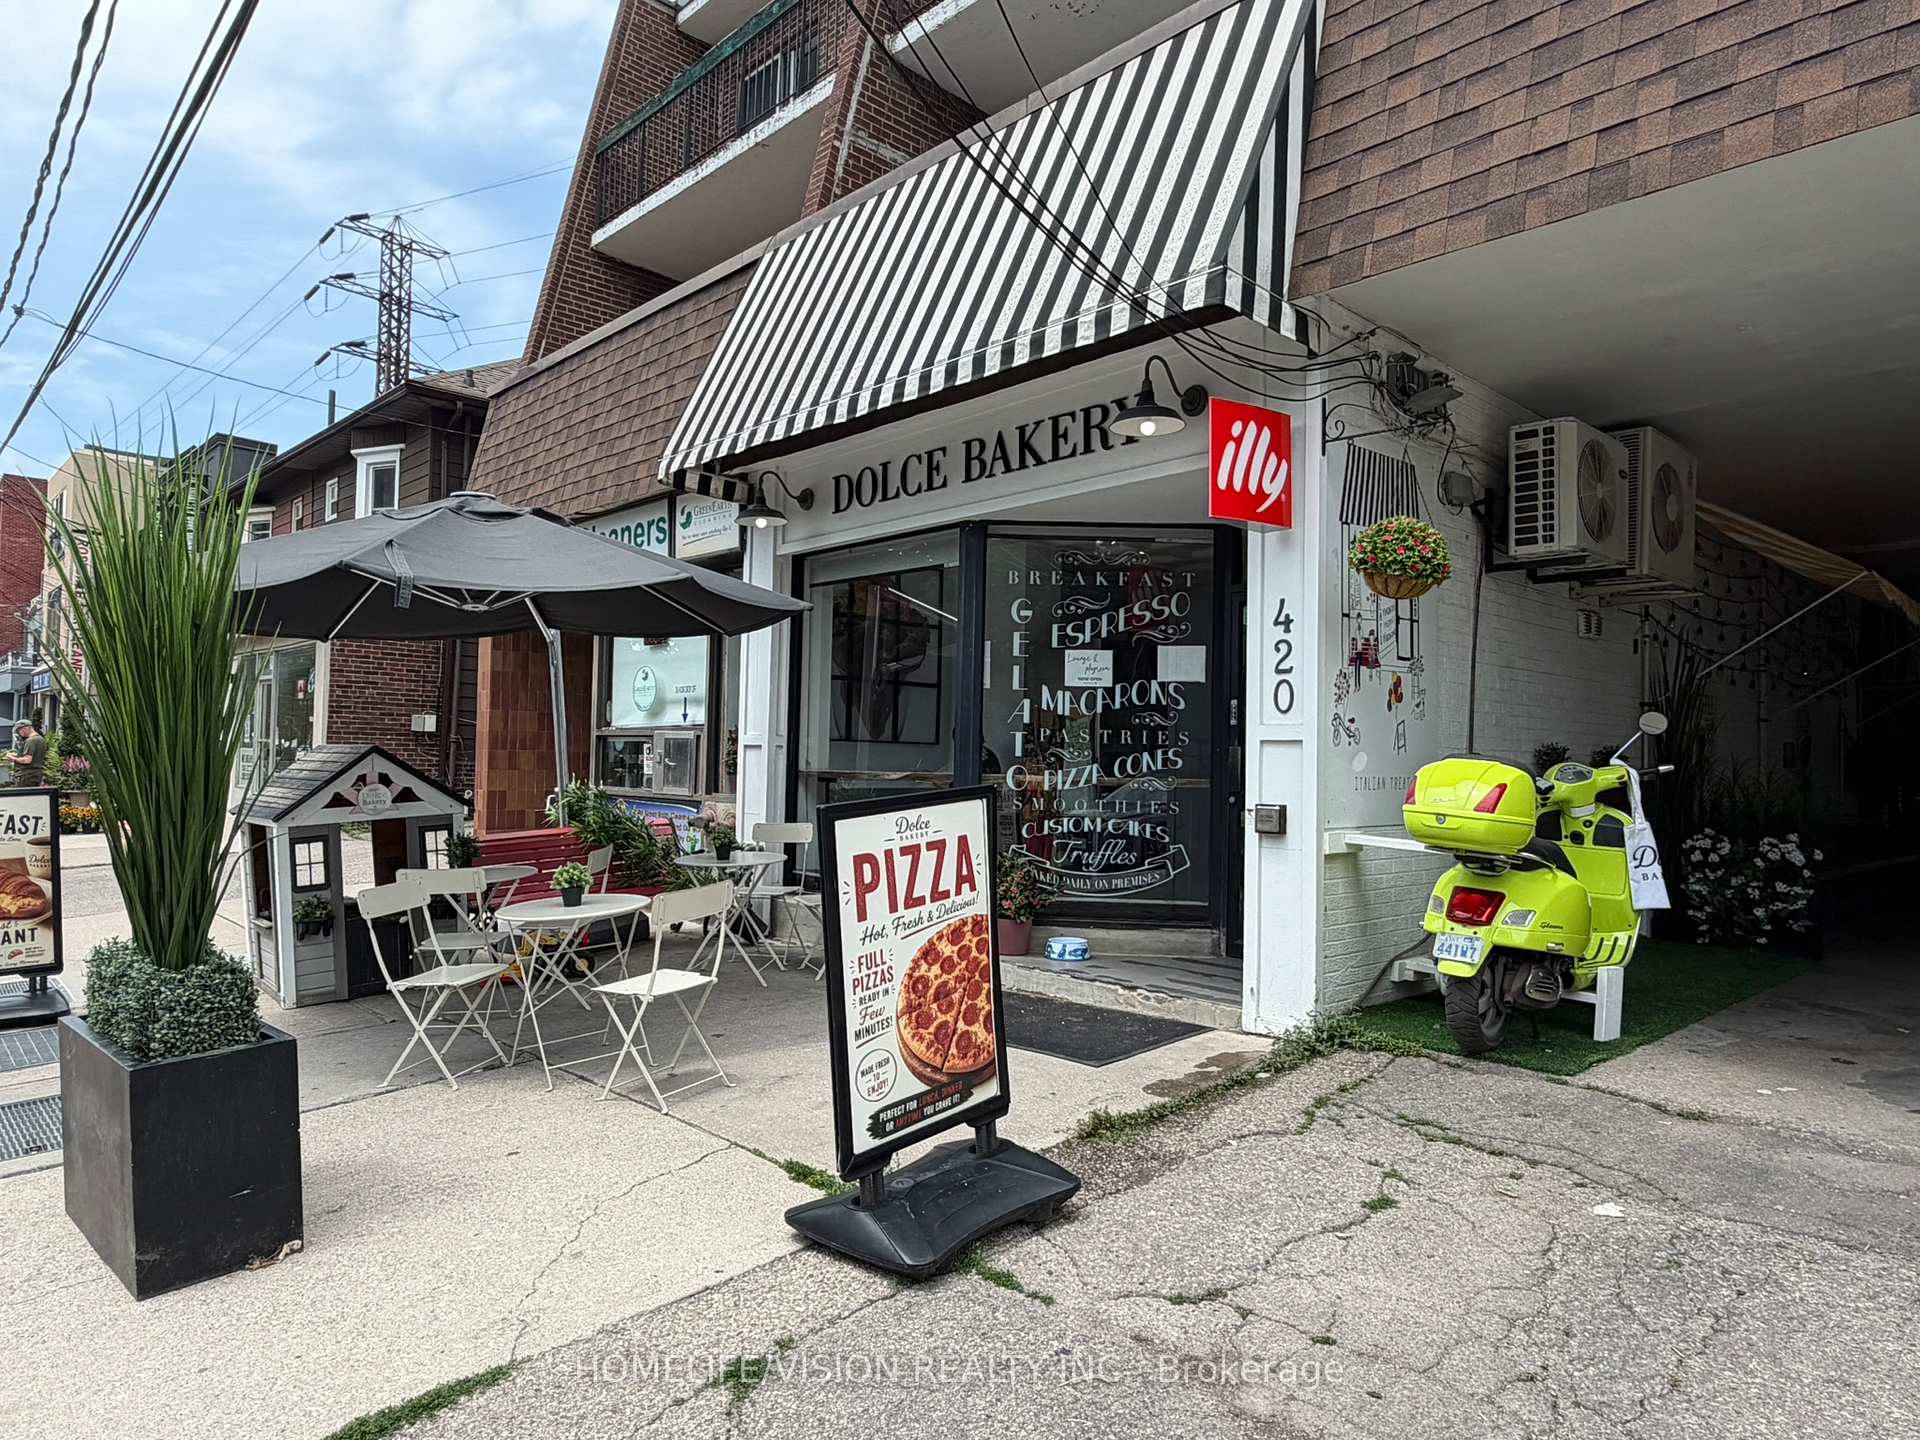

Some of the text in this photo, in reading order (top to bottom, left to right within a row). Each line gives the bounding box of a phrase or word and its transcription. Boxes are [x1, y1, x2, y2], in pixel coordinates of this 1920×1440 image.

[1217, 420, 1288, 513] illy
[831, 446, 948, 514] DOLCE
[583, 516, 667, 547] aners
[1008, 571, 1196, 588] BREAKFAST
[1051, 591, 1190, 649] ESPRESSO
[1273, 598, 1294, 714] 420
[1006, 598, 1032, 791] GELATO
[1041, 680, 1186, 716] MACARONS
[1040, 728, 1189, 746] PASTRIES
[1044, 748, 1183, 791] PIZZA CONES
[1354, 776, 1386, 791] ITALIAN
[1013, 798, 1180, 815] SMOOTHIES
[895, 814, 931, 834] Dolce
[900, 831, 929, 842] BAKERY
[1022, 817, 1101, 838] CUSTOM
[1105, 818, 1170, 843] CAKES
[1053, 839, 1138, 872] Truffles
[852, 834, 977, 923] PIZZA
[1029, 866, 1059, 886] AKED
[1095, 879, 1109, 889] ON
[1112, 874, 1161, 889] PREMISES
[1641, 872, 1660, 881] BA
[859, 891, 980, 946] Hot, Fresh & Delicious!
[858, 949, 887, 973] FULL
[852, 965, 894, 995] PIZZAS
[859, 987, 890, 1006] READY IN
[859, 1004, 885, 1026] Few
[854, 1016, 893, 1041] MINUTES!
[867, 1078, 889, 1096] ENJOY!
[873, 1072, 880, 1081] TO
[880, 1104, 905, 1122] PERFECT
[906, 1100, 918, 1111] FOR
[885, 1121, 895, 1132] OR
[923, 1106, 935, 1116] YOU
